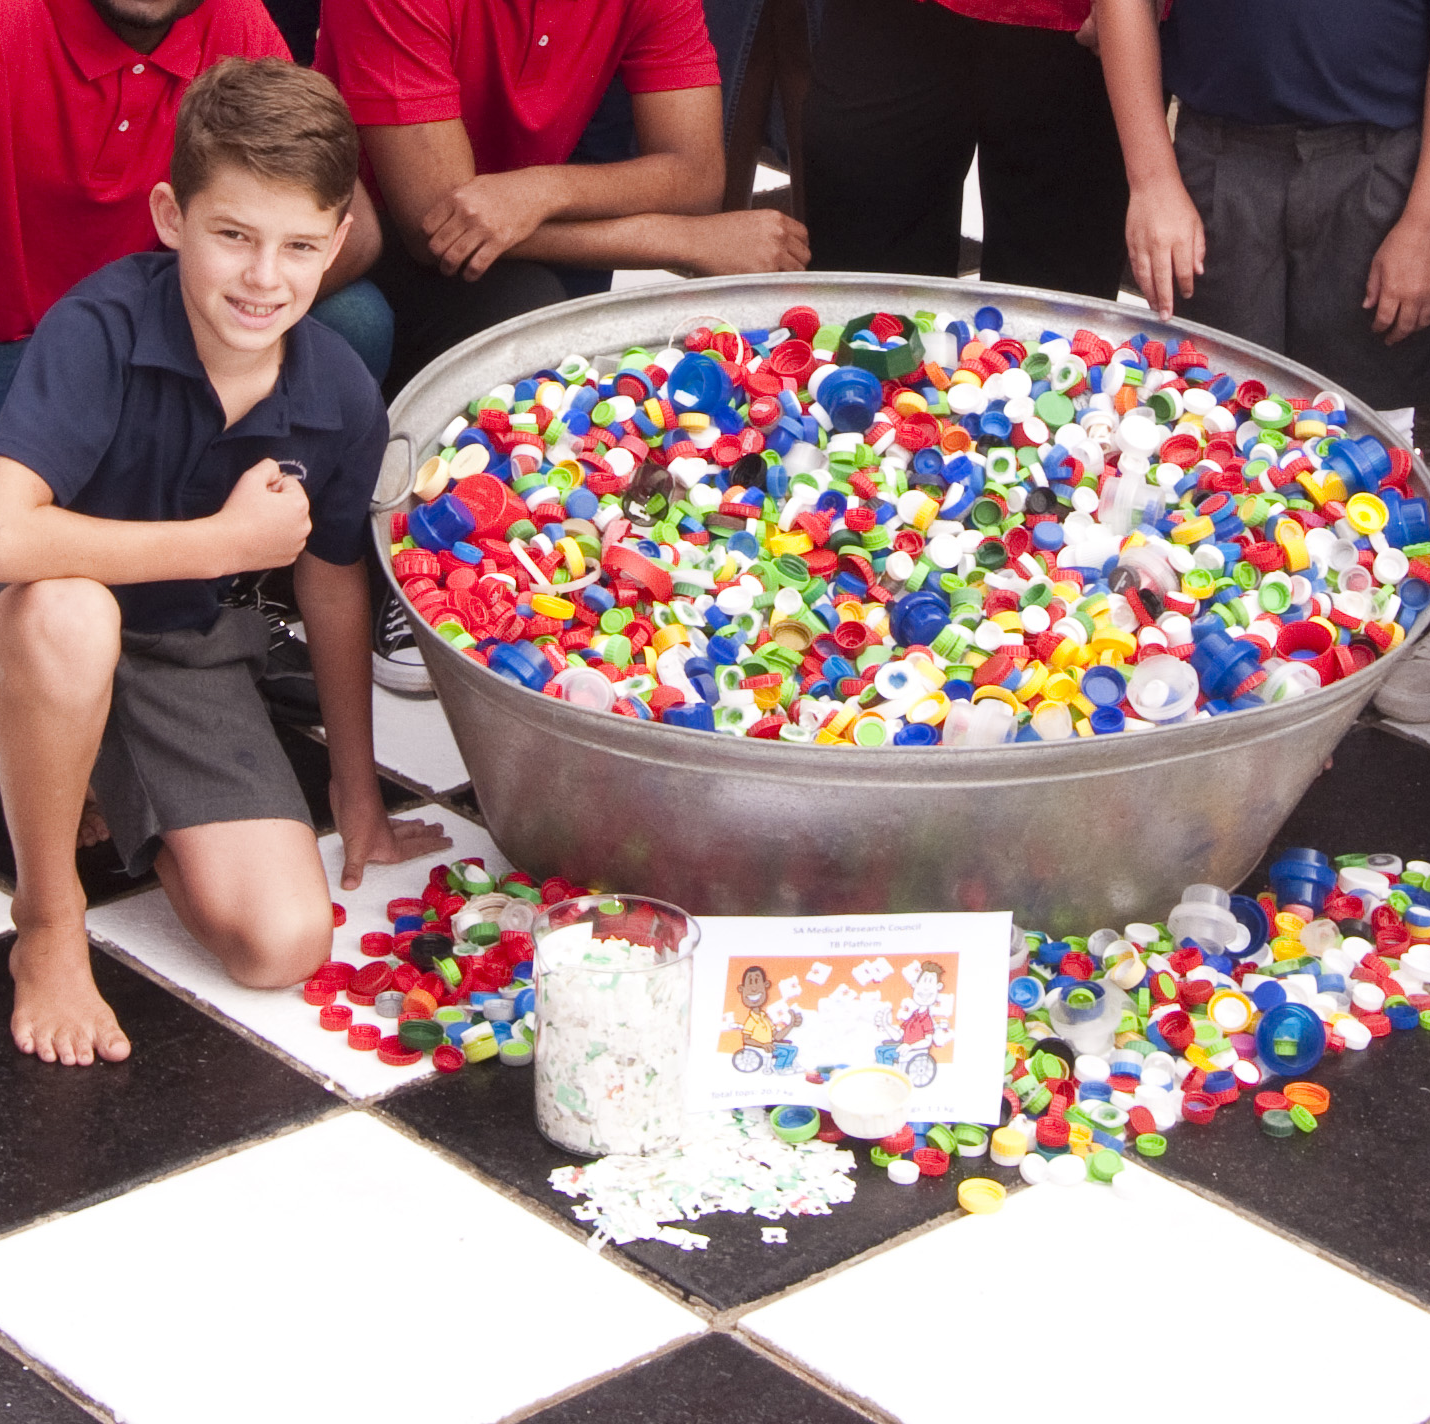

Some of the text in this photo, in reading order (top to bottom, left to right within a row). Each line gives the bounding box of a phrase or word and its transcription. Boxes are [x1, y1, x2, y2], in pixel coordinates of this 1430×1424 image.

[807, 926, 843, 934] Medical
[845, 924, 885, 933] Research
[888, 923, 921, 932] Council
[843, 940, 882, 948] Platform
[711, 1090, 732, 1099] Total
